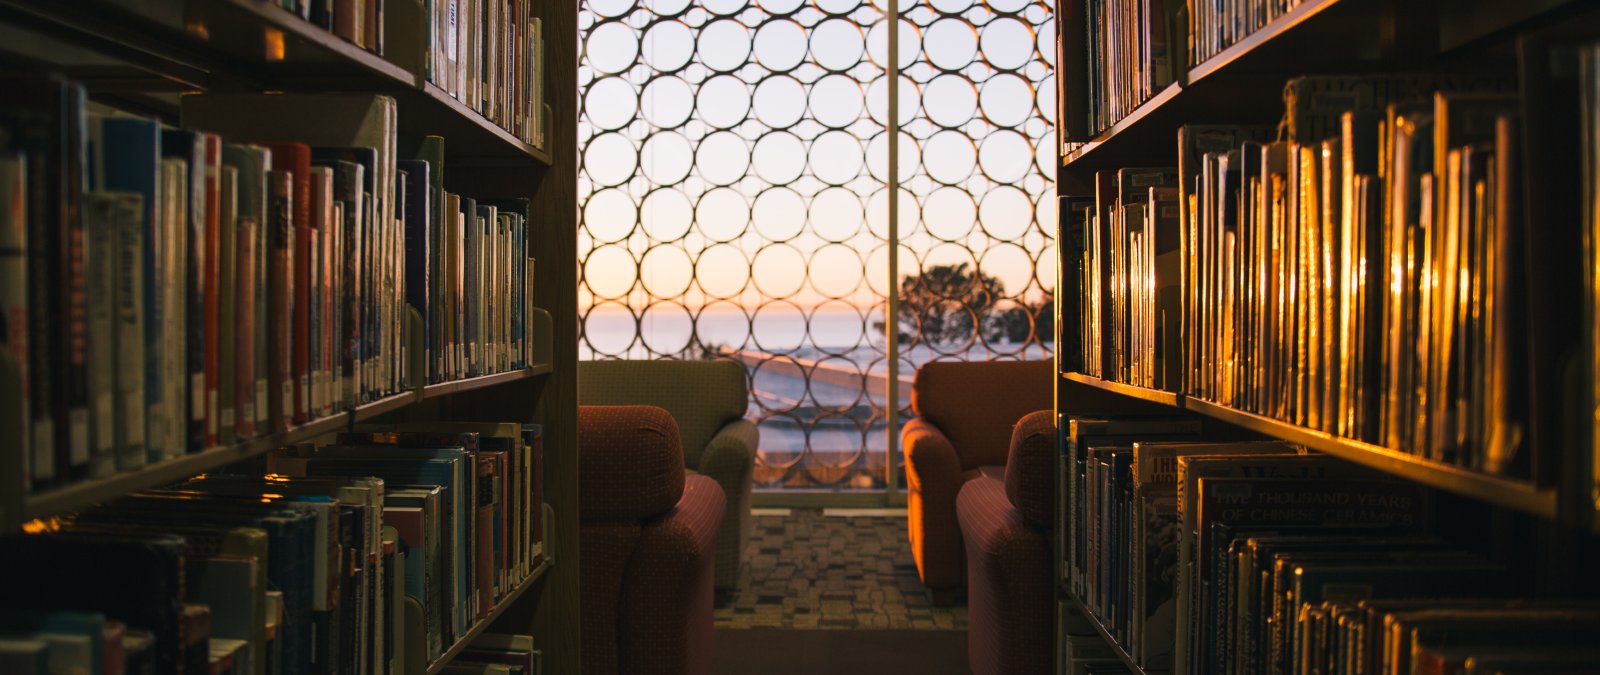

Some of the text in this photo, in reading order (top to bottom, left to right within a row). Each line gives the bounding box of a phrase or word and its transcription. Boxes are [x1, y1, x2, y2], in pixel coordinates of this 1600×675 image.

[1255, 492, 1350, 505] THOUSAND
[1359, 493, 1412, 509] YEARS
[1222, 508, 1413, 525] OF CHINESE CERAMICS
